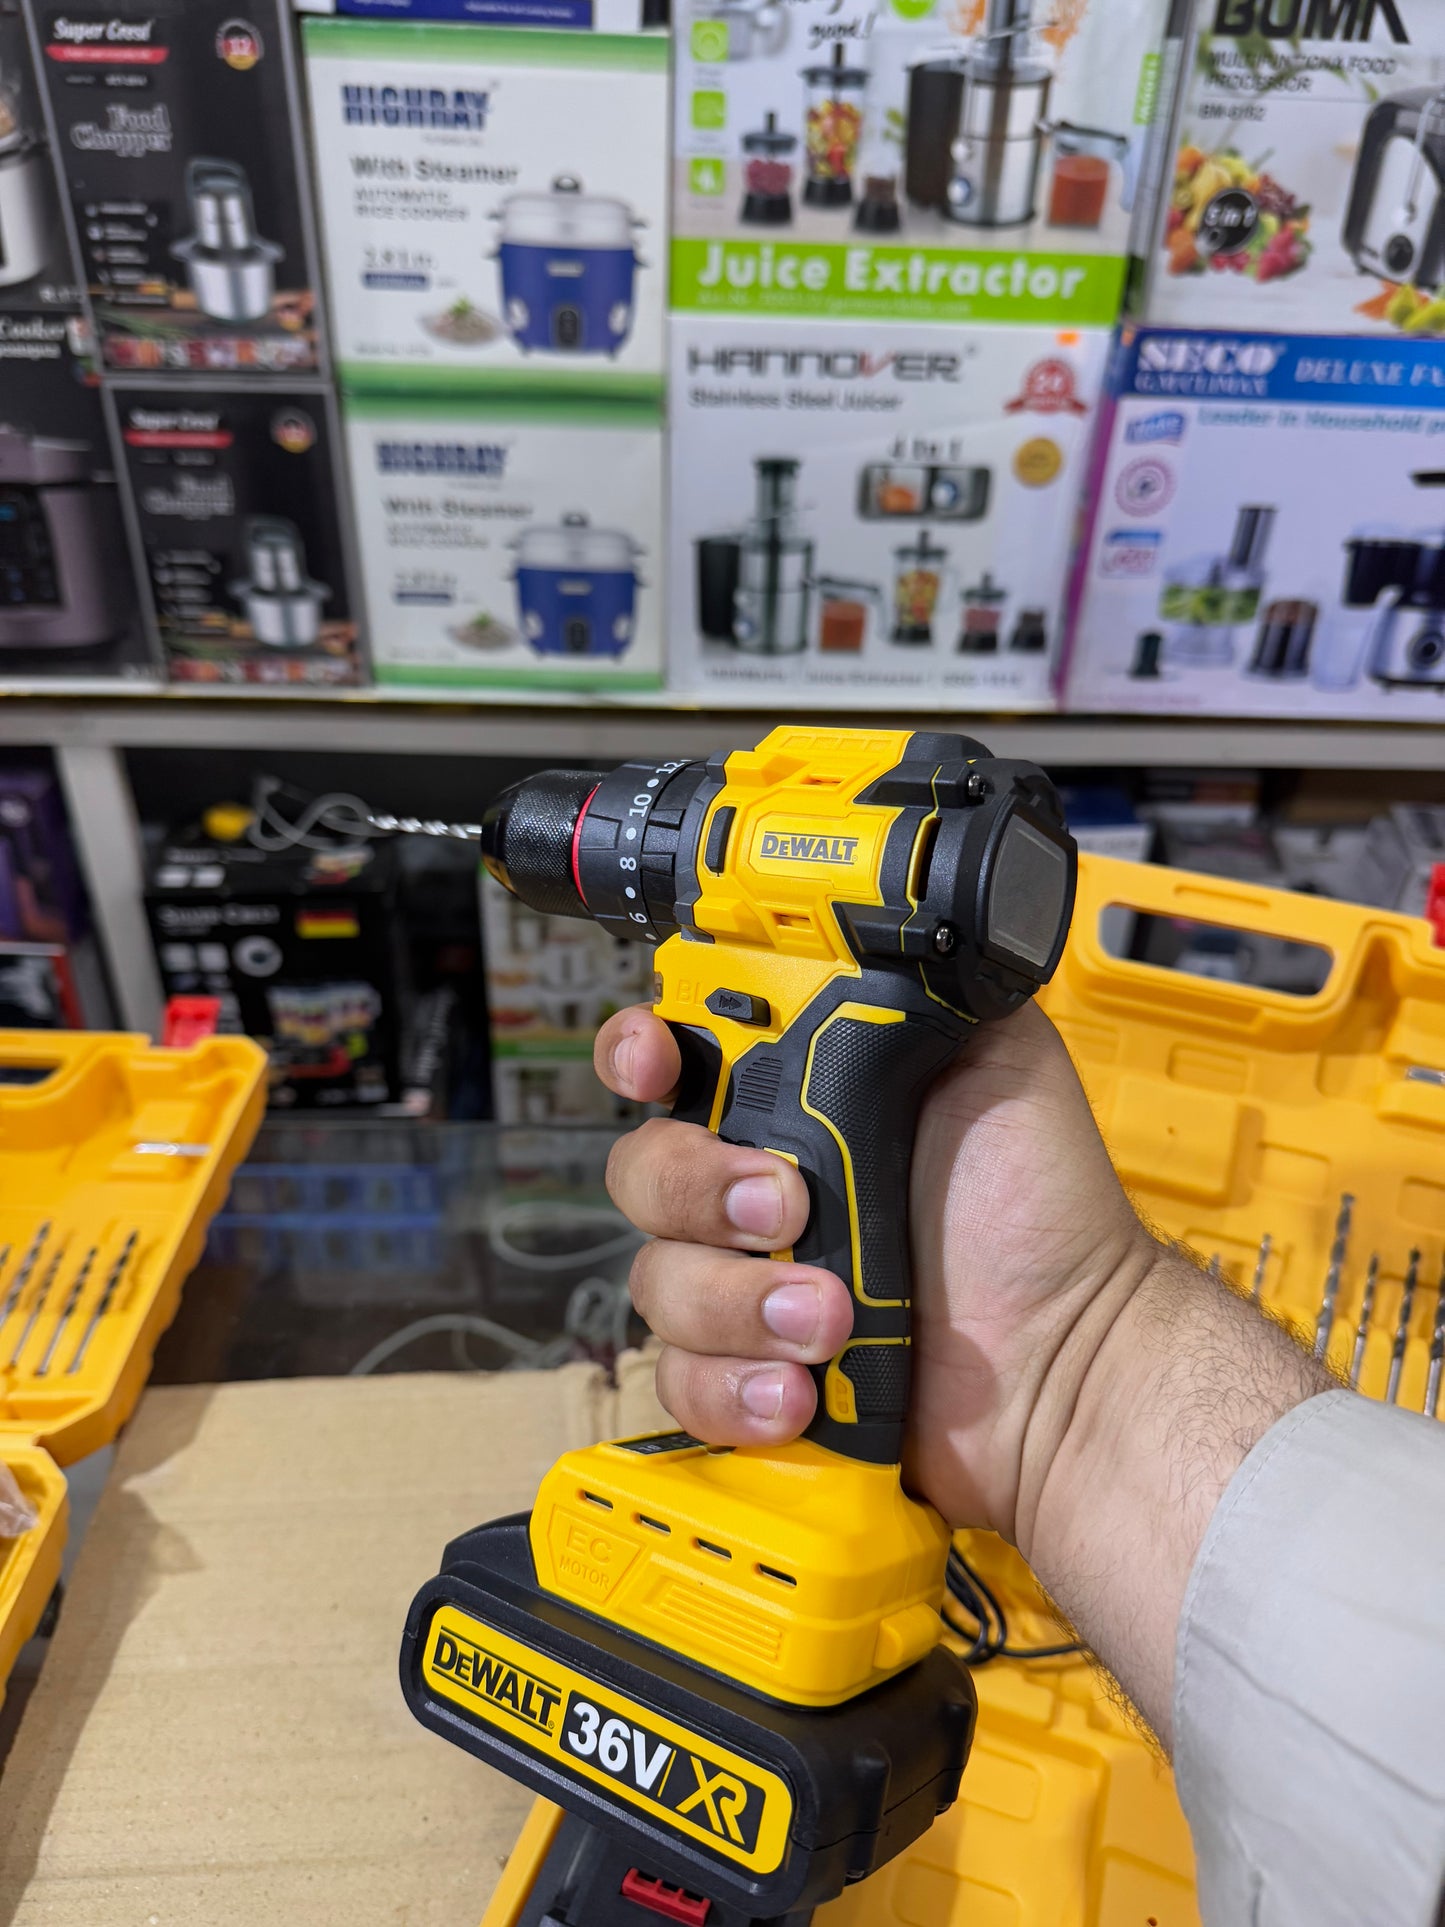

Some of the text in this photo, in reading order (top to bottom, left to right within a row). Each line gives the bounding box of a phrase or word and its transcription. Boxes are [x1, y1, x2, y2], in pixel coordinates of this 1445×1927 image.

[351, 156, 518, 185] With Steamer
[697, 241, 1088, 300] Juice Extractor
[686, 344, 963, 384] HANNOVER
[1137, 337, 1278, 376] SECO
[1294, 357, 1405, 386] DELUXE
[629, 793, 653, 819] 10
[619, 856, 637, 872] 8
[628, 911, 648, 925] 6
[566, 1524, 612, 1564] EC
[559, 1553, 610, 1591] MOTOR
[566, 1701, 748, 1846] 36V XR
